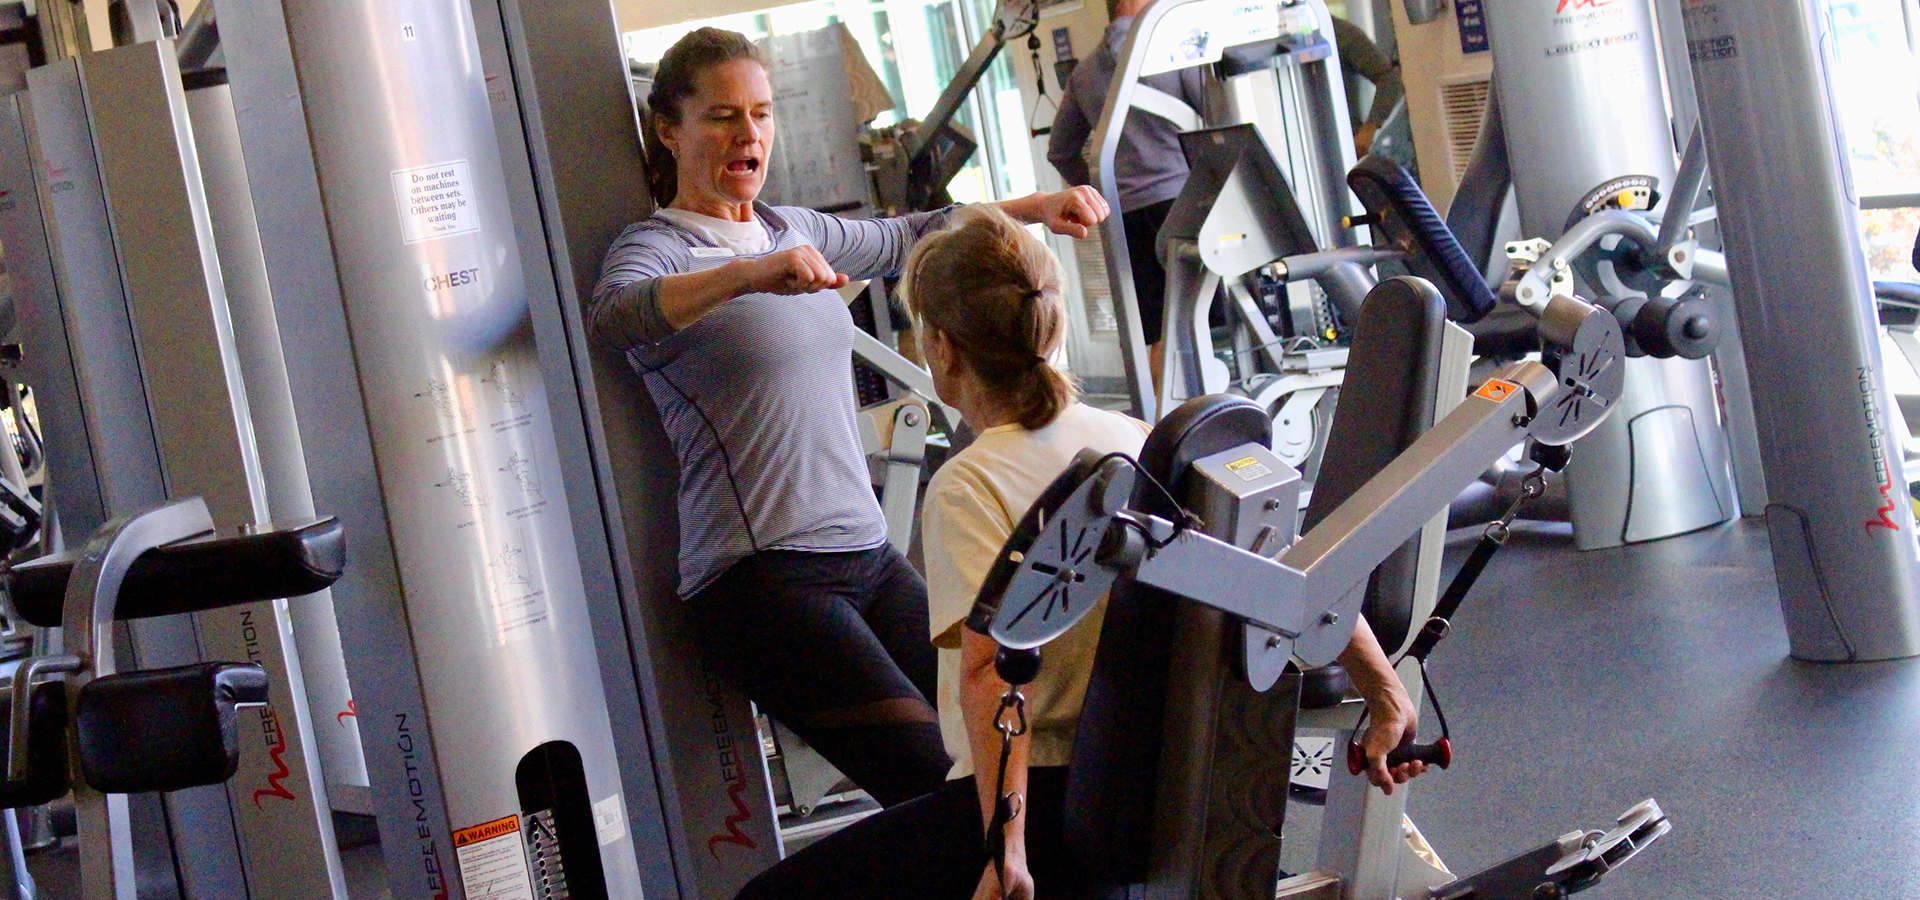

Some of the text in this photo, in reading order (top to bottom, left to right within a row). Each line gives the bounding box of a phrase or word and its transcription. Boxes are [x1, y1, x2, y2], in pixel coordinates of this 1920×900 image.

[403, 25, 414, 38] 11
[411, 169, 455, 184] Do not rest
[411, 180, 460, 194] on machines
[410, 190, 464, 205] between sets.
[410, 198, 467, 216] Others may be
[428, 212, 457, 223] waiting
[423, 268, 479, 291] CHEST
[1856, 366, 1887, 484] FREEMOTION
[240, 611, 278, 746] FRETION
[395, 713, 441, 890] FREEMOTION
[468, 820, 516, 841] WARNING
